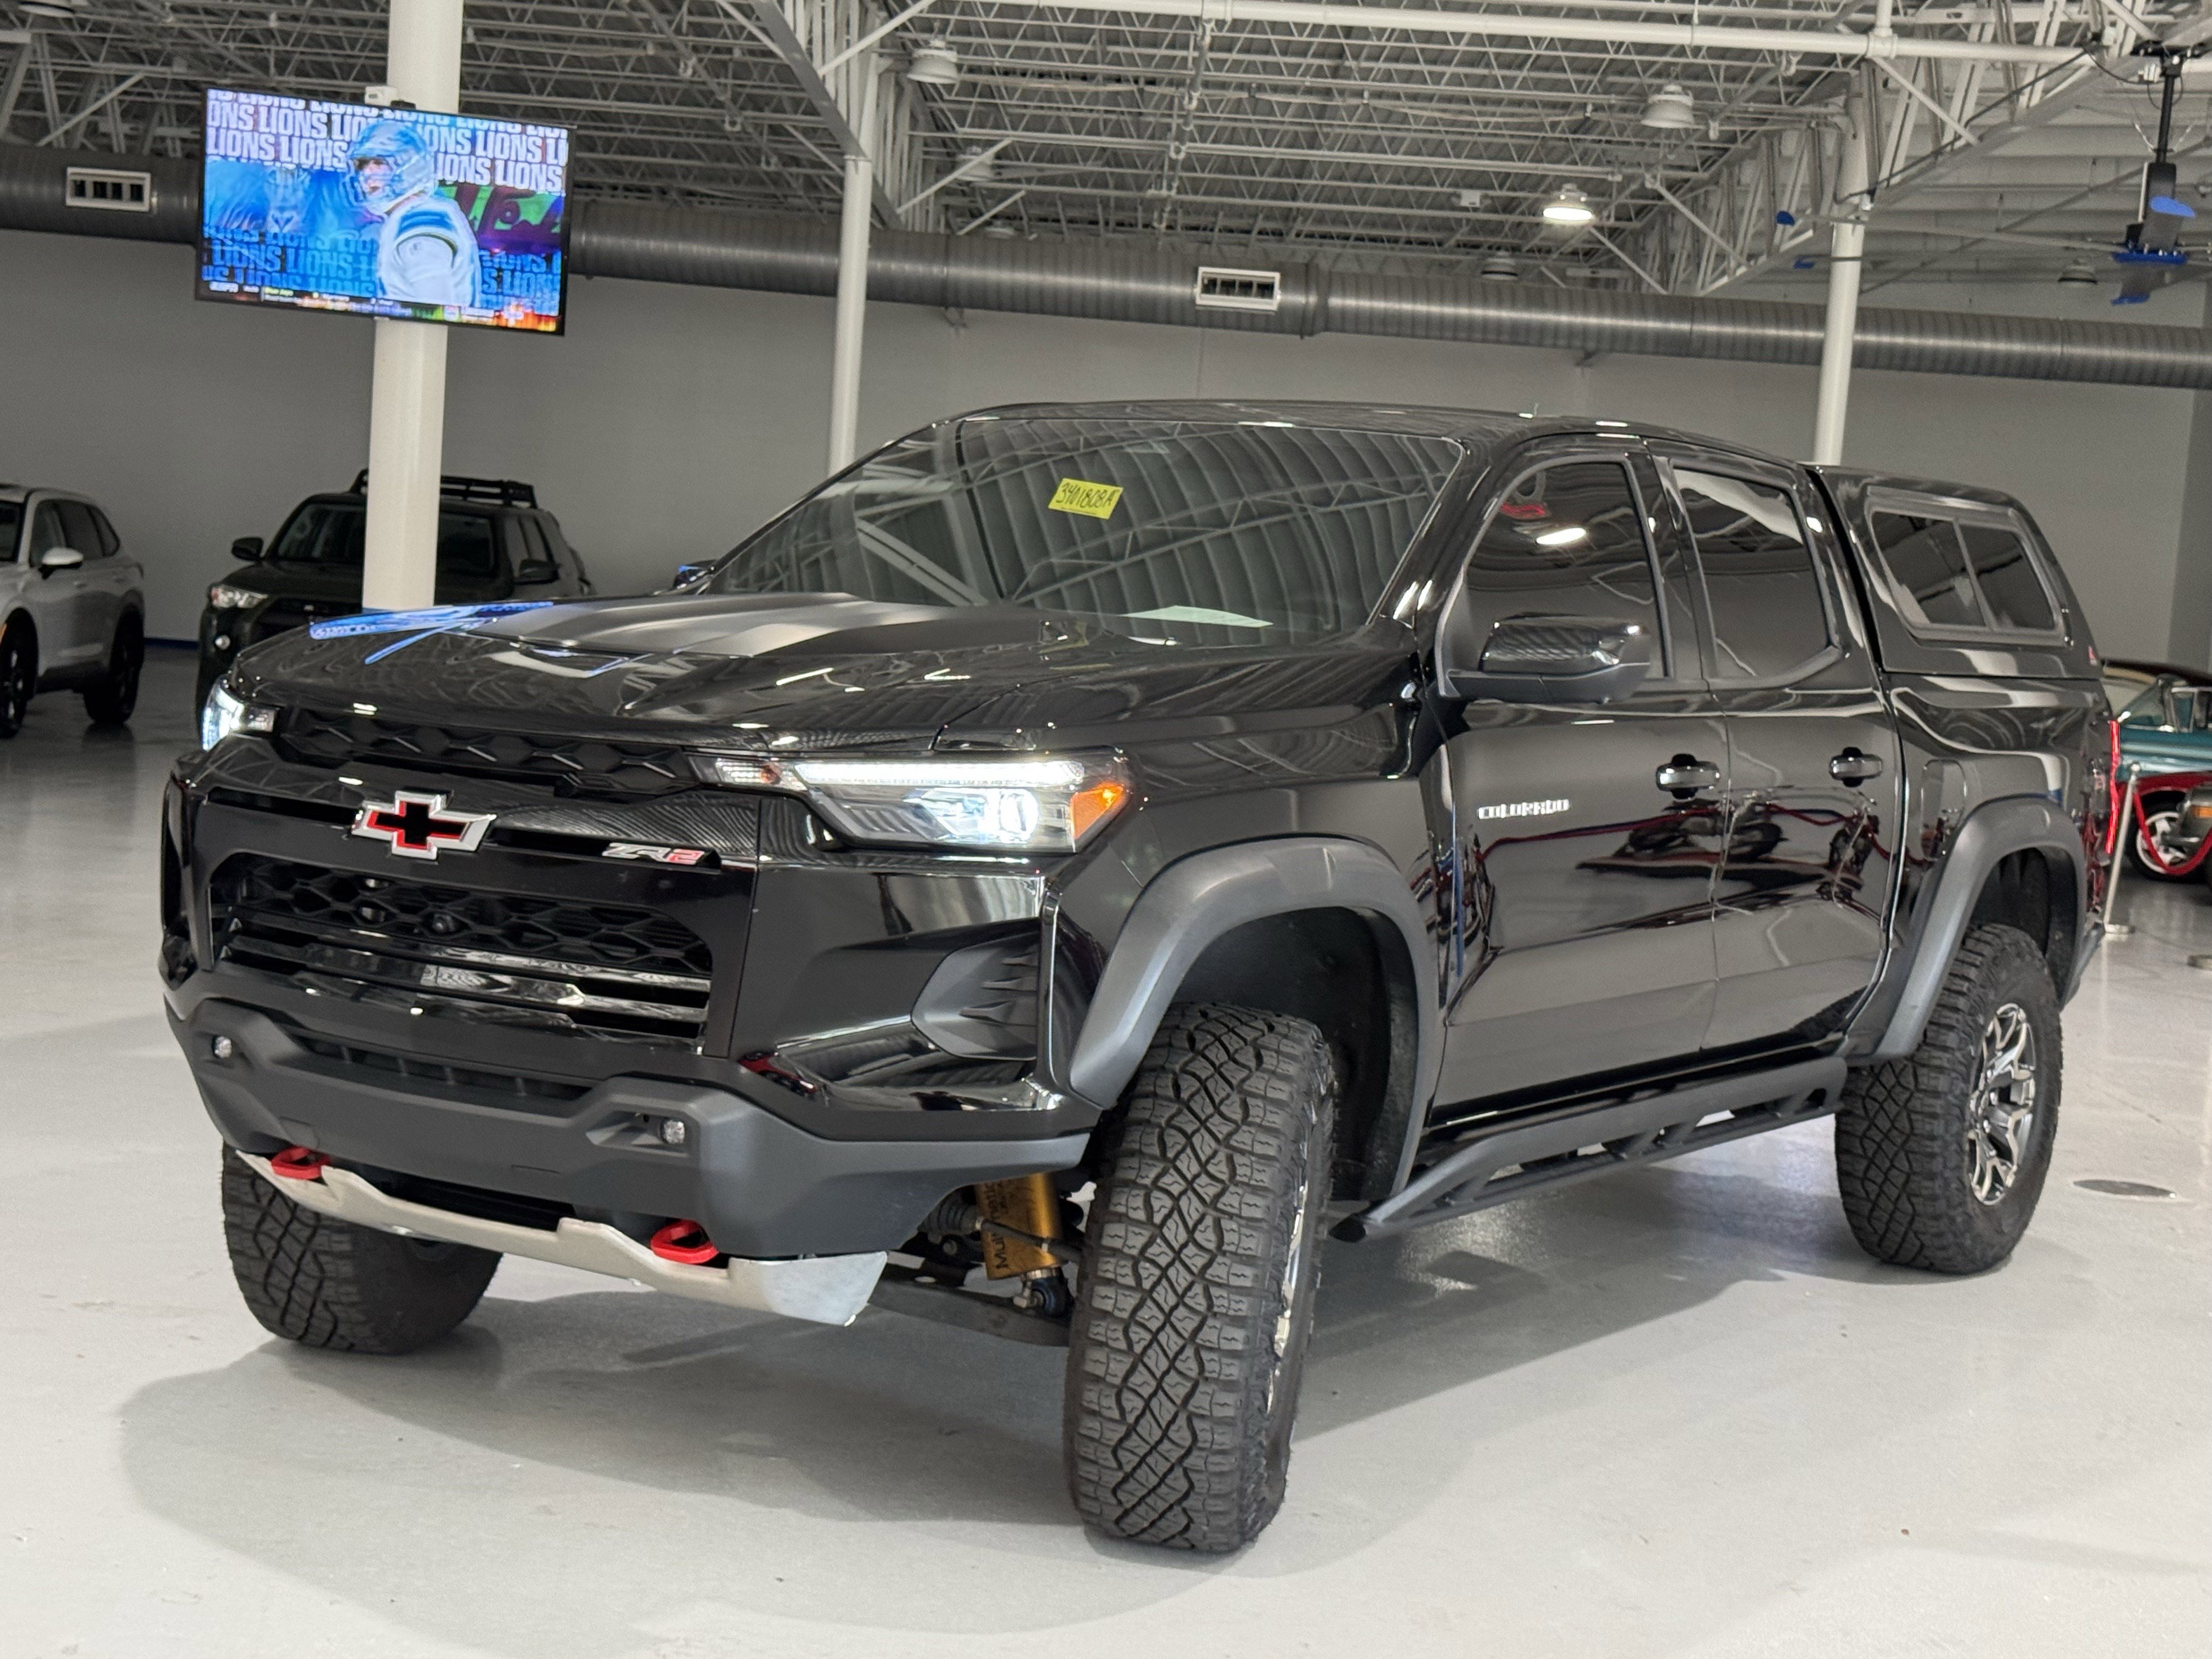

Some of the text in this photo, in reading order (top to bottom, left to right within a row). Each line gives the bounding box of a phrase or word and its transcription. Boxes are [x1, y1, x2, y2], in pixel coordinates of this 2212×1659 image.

[258, 105, 328, 138] LIONS
[475, 130, 543, 163] LIONS
[206, 127, 563, 193] LIONS LIONS IONS LIONS
[286, 248, 353, 280] LIONS
[1477, 799, 1570, 820] COLORADO
[602, 842, 705, 865] ZR2
